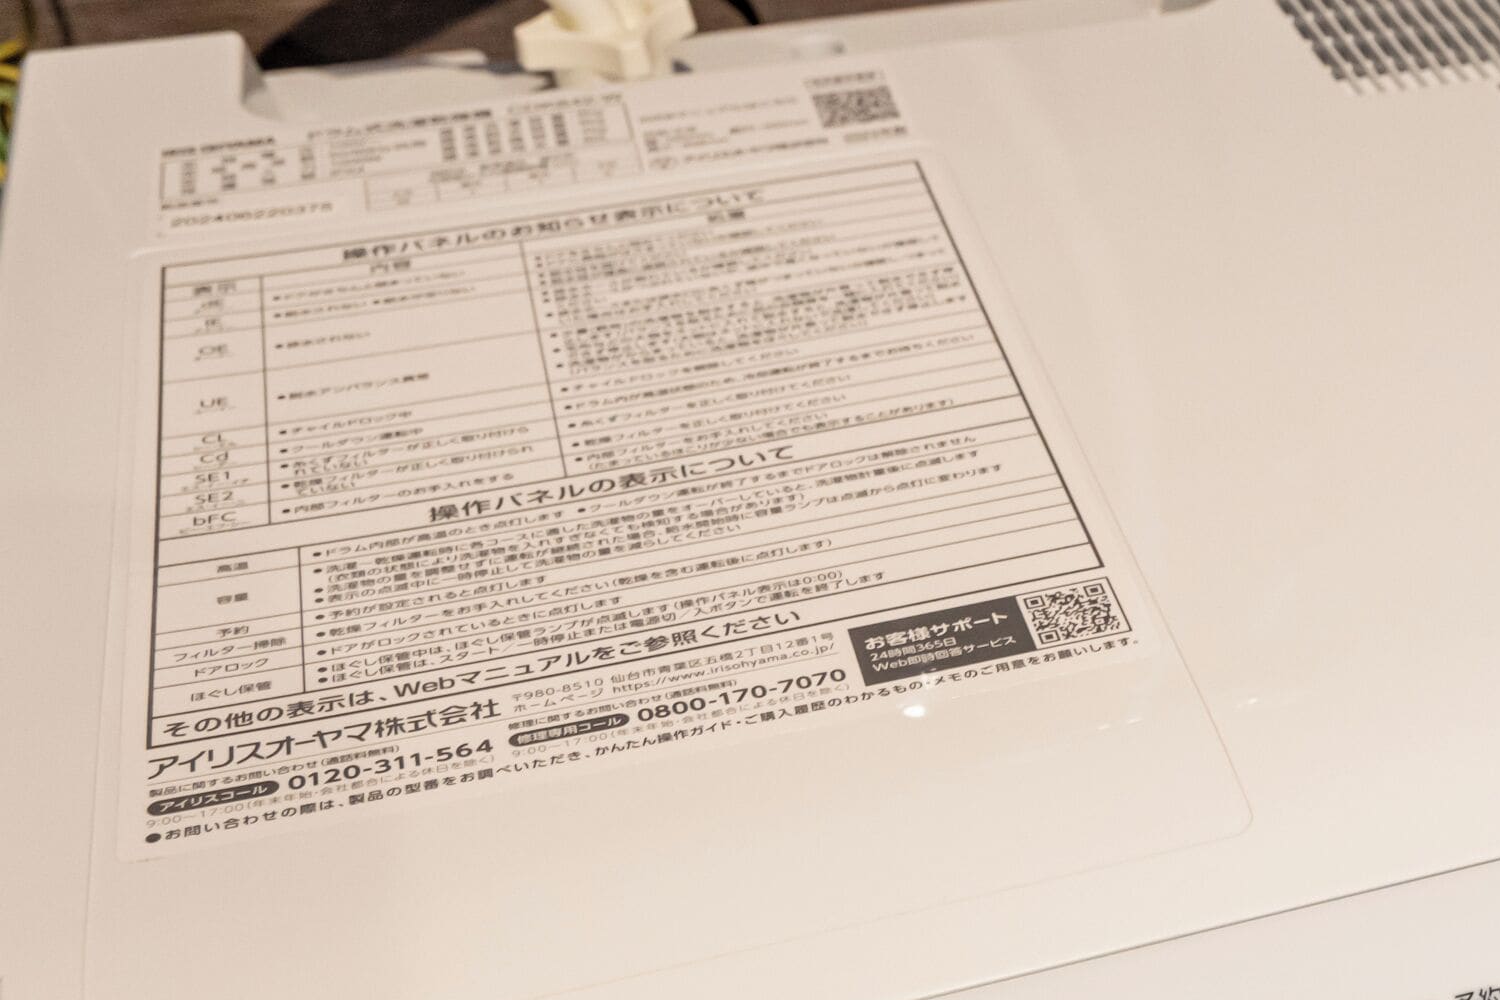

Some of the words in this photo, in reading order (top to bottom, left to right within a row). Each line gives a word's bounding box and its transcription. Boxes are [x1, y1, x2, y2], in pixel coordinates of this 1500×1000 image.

[194, 490, 233, 507] SE2
[427, 444, 797, 522] 操作パネルの表示について
[191, 510, 236, 528] bFC
[215, 624, 250, 639] 予約
[330, 595, 623, 656] ドアがロックされているときに点灯します
[862, 609, 1010, 651] お客様サポート
[172, 634, 287, 664] フィルター掃除
[868, 636, 958, 662] 24時間365日
[162, 609, 801, 740] その他の表示は、Webマニュアルをご参照ください
[193, 656, 269, 679] ドアロック
[512, 686, 604, 712] ホームページ
[611, 641, 837, 696] https://www.irisohyama.co.jp/
[190, 679, 273, 703] ほぐし保管
[635, 667, 849, 723] 0800-170-7070
[147, 696, 502, 781] アイリスオーヤマ株式会社
[287, 737, 494, 791] 0120-311-564
[158, 783, 268, 813] アイリスコール
